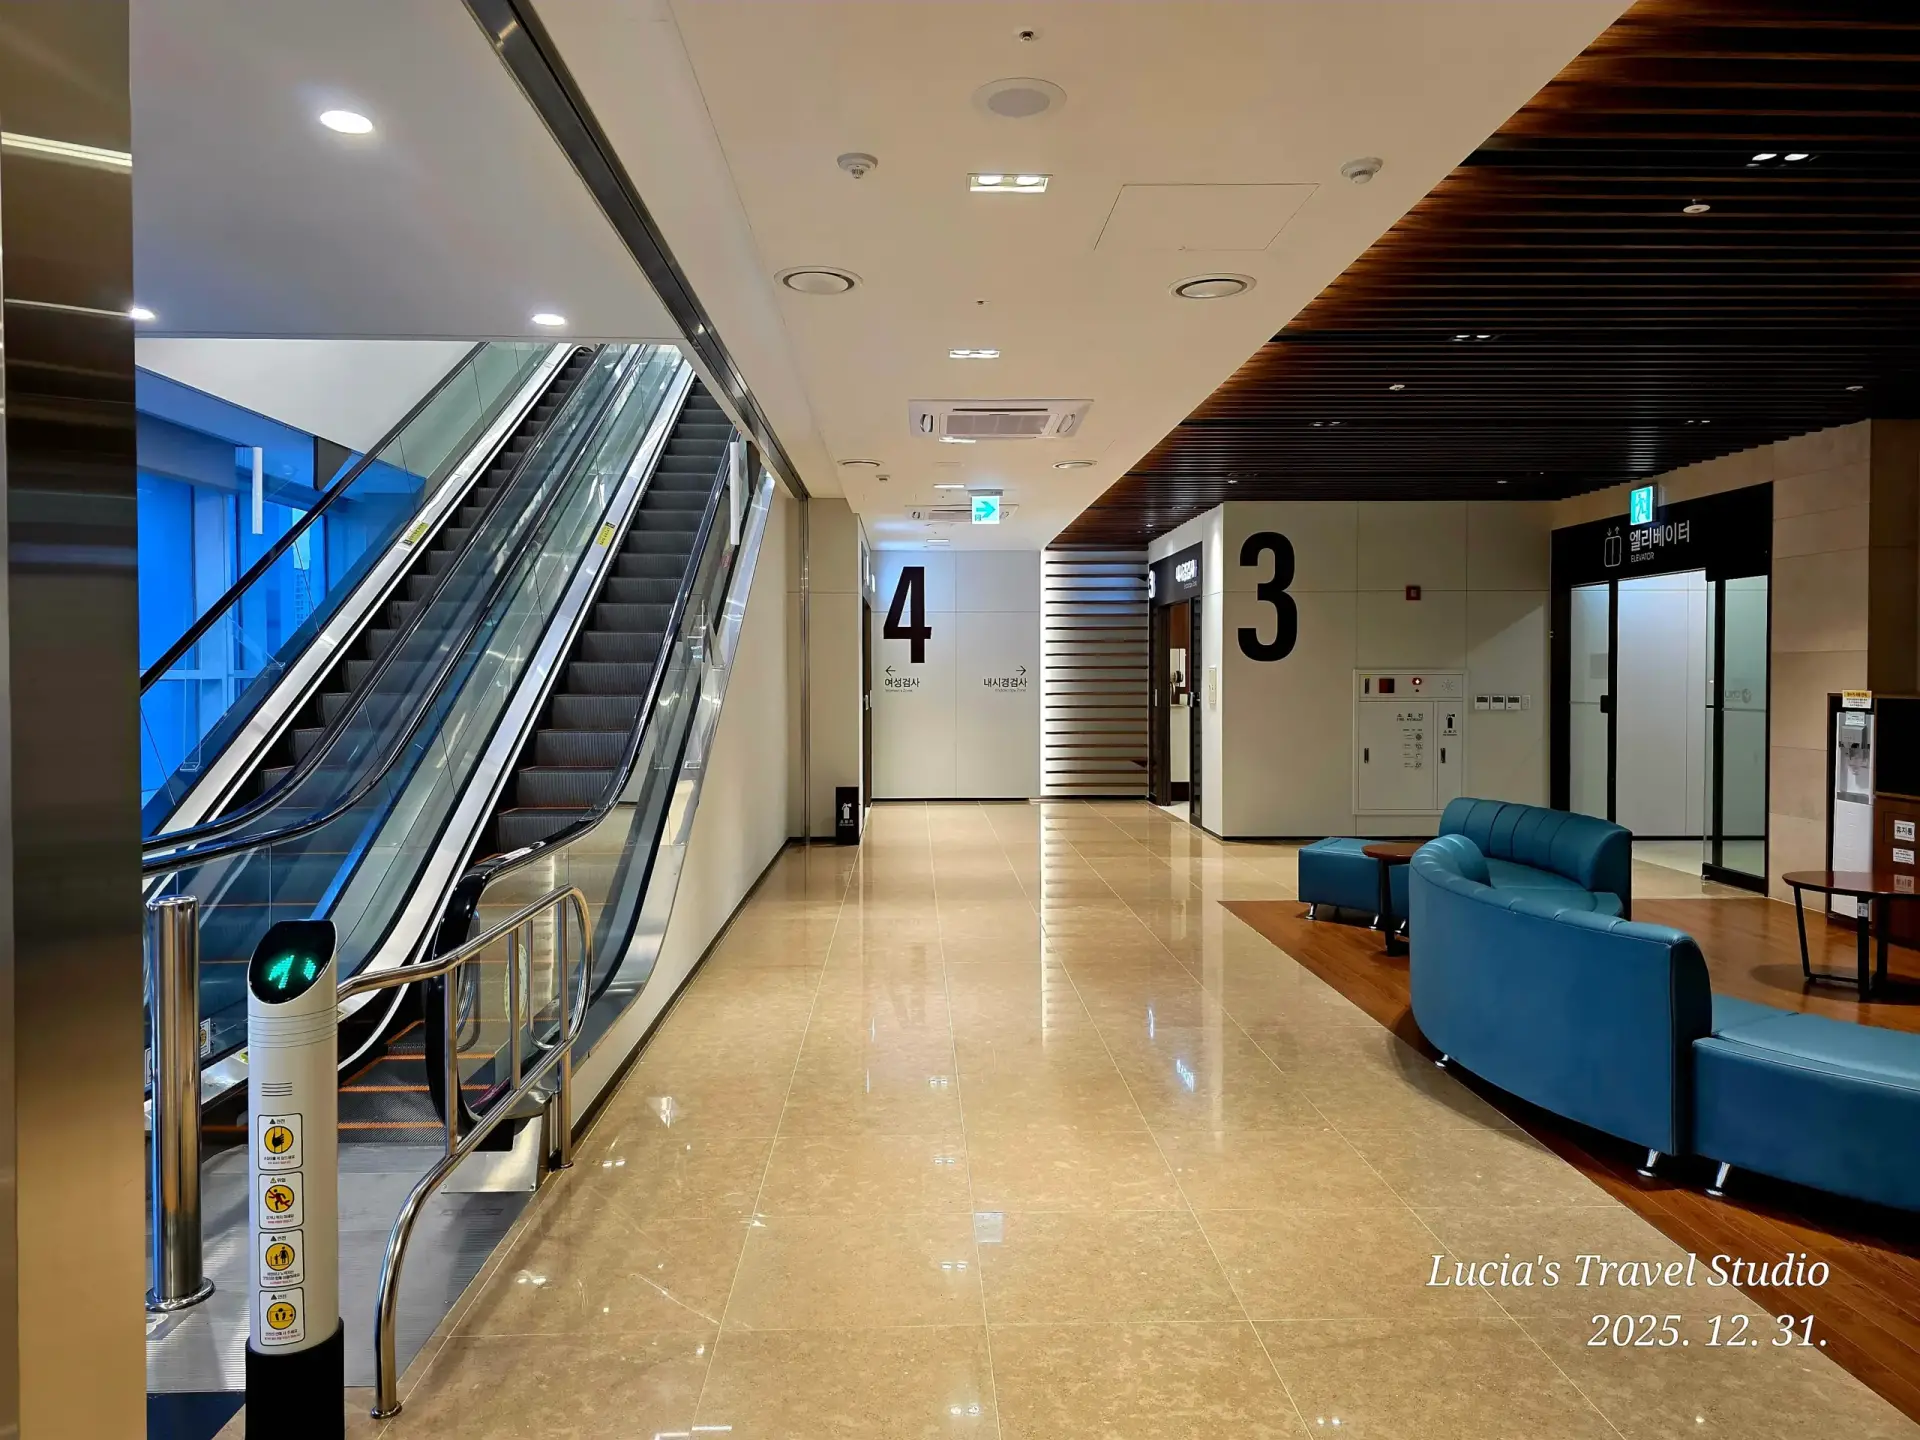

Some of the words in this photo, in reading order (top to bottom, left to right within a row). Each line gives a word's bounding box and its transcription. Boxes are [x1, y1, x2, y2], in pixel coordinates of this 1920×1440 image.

[1629, 519, 1690, 552] 엘리베이터
[1630, 551, 1655, 563] ELEVATOR
[1238, 531, 1298, 662] 3
[883, 566, 932, 664] 4
[884, 677, 920, 688] 여성검사
[983, 677, 1027, 688] 내시경검사
